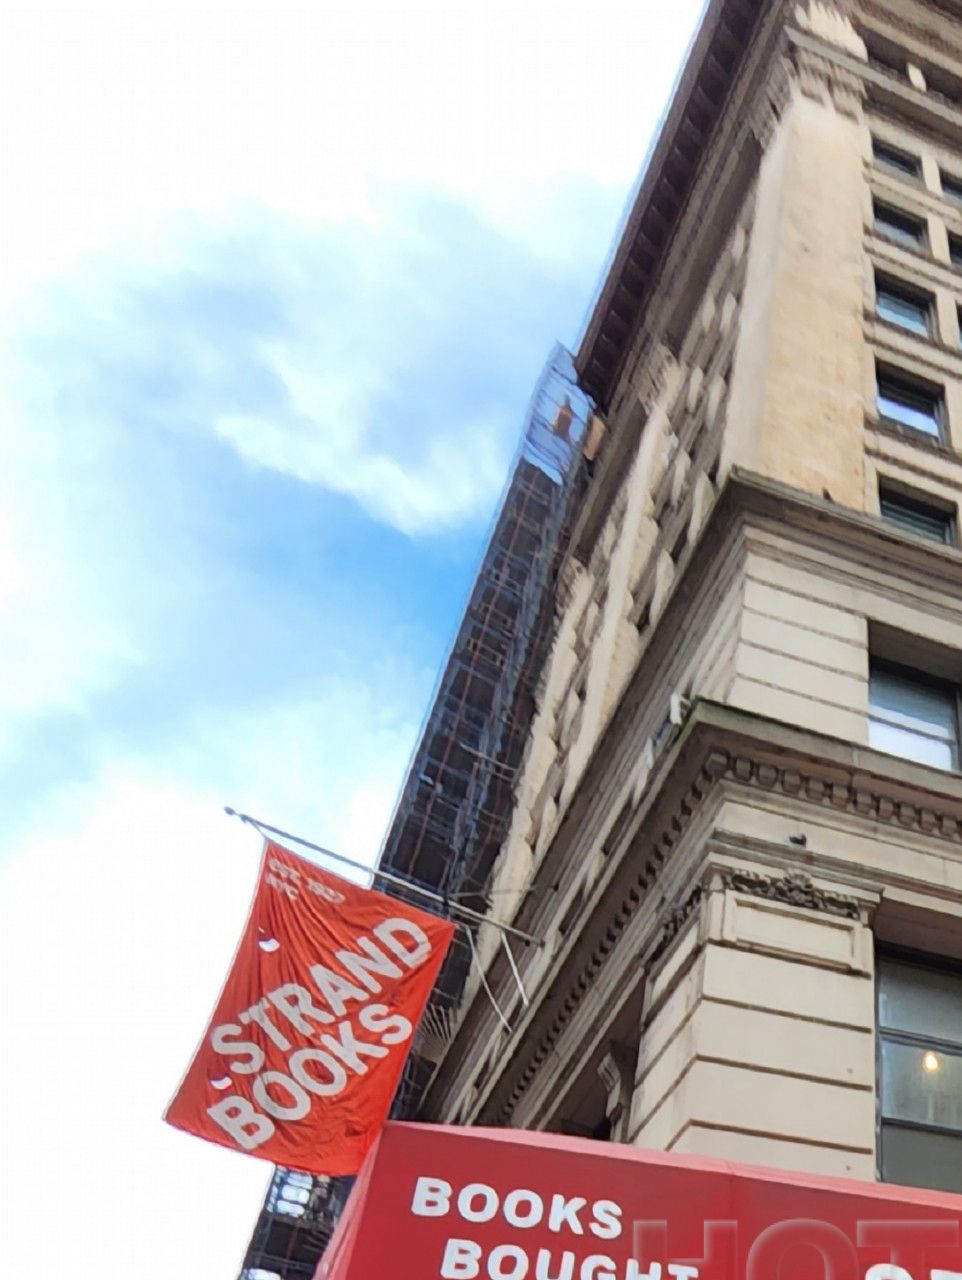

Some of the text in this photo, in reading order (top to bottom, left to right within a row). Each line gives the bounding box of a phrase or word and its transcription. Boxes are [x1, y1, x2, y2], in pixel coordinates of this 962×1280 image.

[210, 918, 432, 1074] STRAND
[206, 1004, 412, 1150] BOOKS
[411, 1177, 622, 1239] BOOKS
